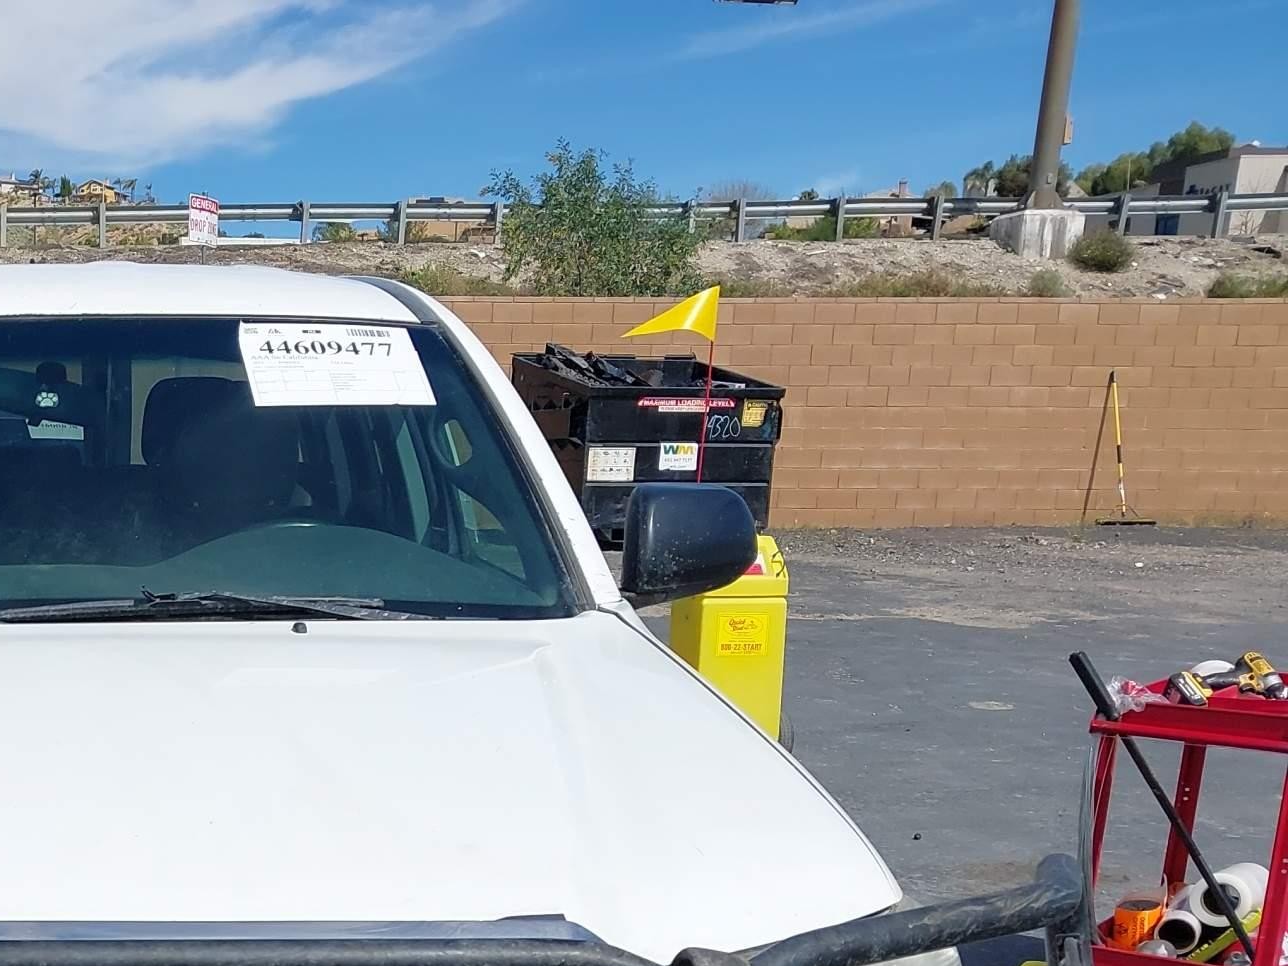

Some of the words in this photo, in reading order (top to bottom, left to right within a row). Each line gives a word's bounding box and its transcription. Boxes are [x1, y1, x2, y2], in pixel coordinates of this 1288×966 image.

[191, 219, 206, 232] DROP
[259, 340, 392, 357] 44609477
[663, 444, 694, 455] WM
